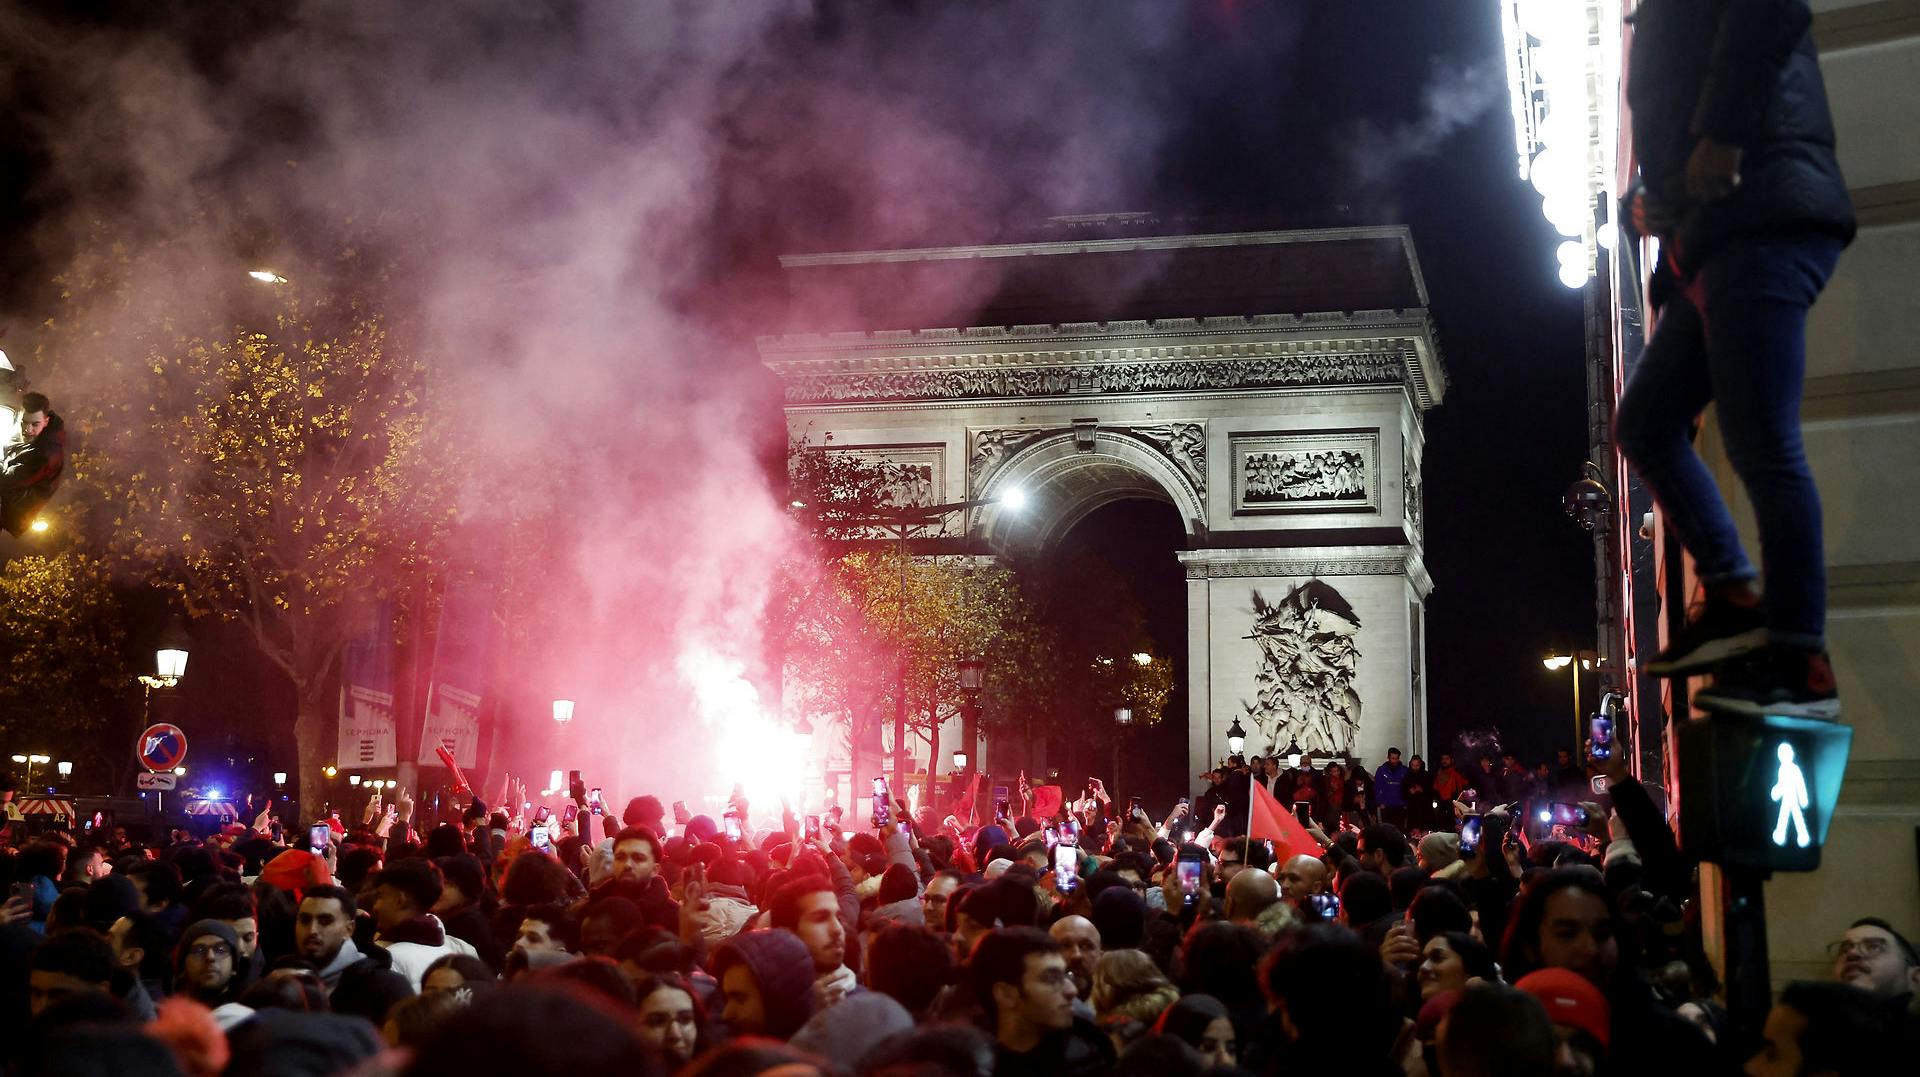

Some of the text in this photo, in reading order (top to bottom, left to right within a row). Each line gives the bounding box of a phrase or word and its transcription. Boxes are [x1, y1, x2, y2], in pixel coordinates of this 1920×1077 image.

[345, 728, 389, 736] SEPHORA
[428, 727, 470, 736] SEPHORA
[54, 814, 65, 823] A2
[220, 814, 230, 823] A1
